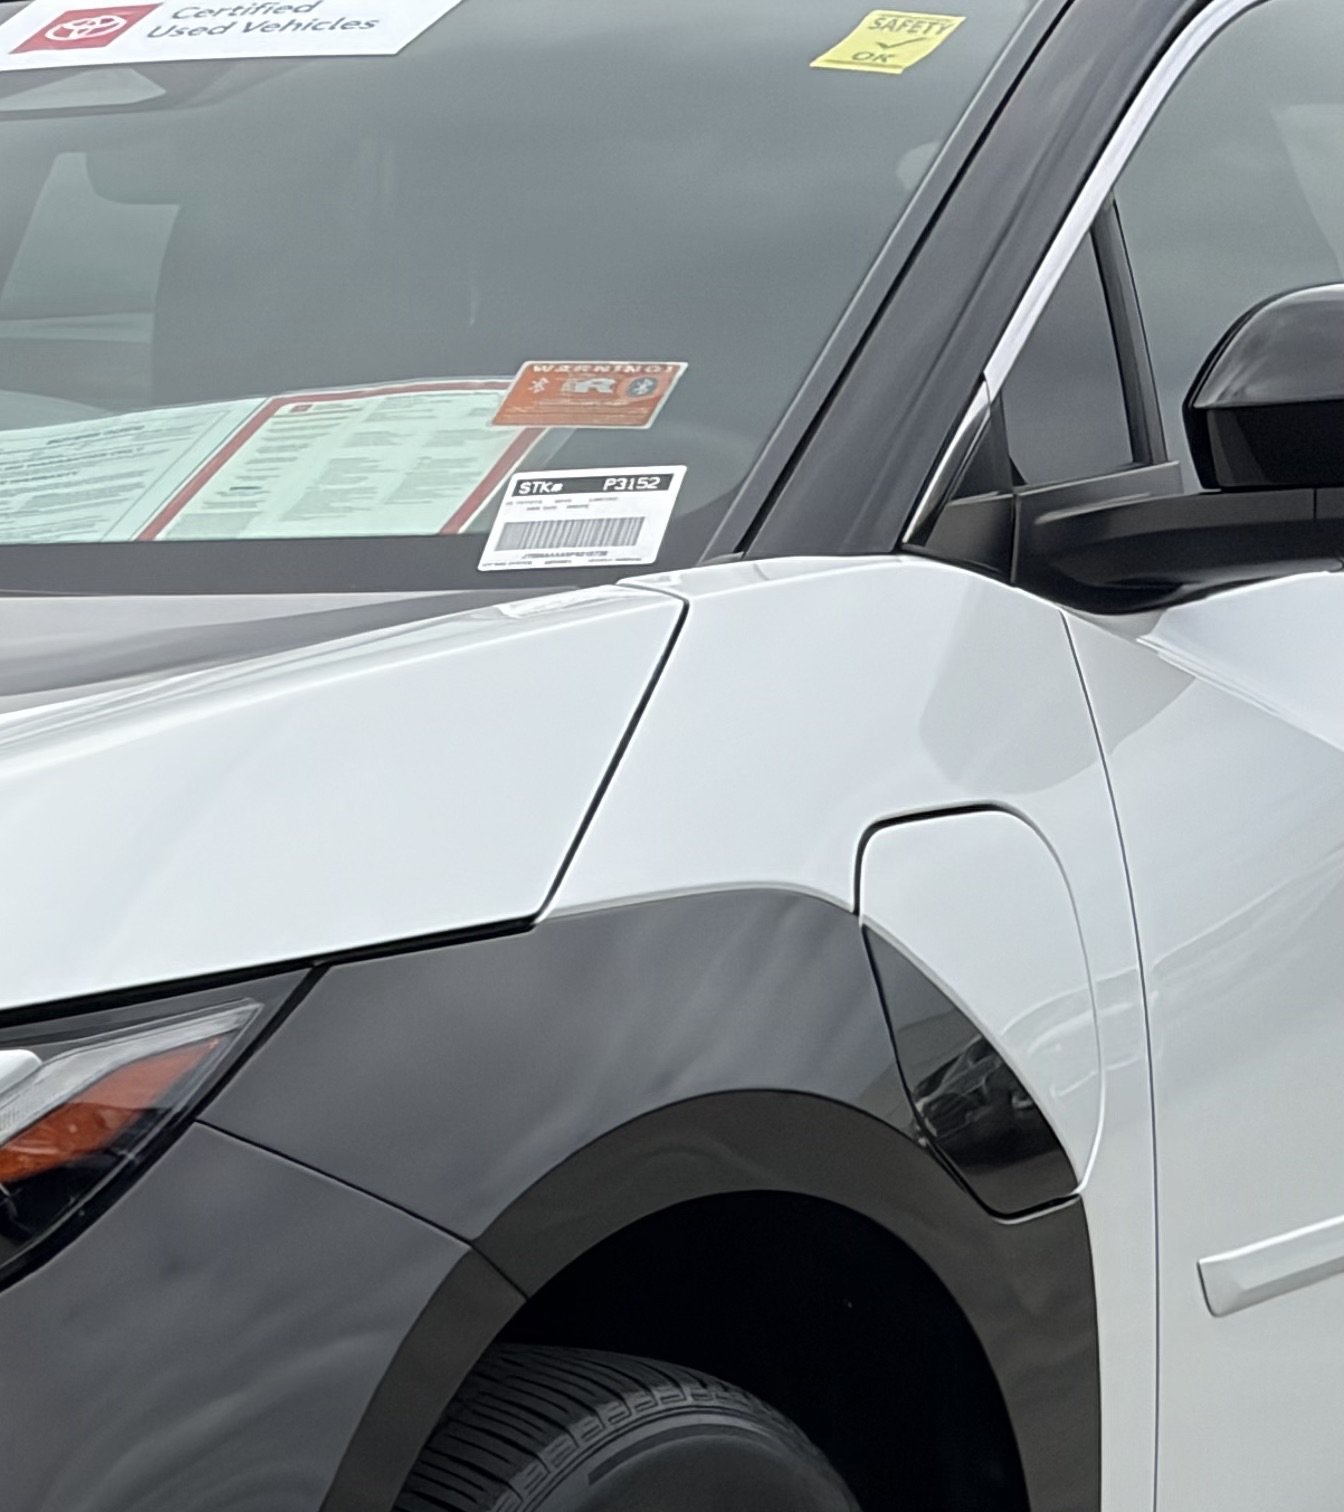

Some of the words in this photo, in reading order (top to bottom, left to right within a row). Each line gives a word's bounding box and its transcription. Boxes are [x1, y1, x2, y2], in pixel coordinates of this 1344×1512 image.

[170, 0, 321, 19] Certified
[147, 21, 234, 38] Used
[241, 17, 380, 34] Vehicles
[868, 18, 954, 35] SAFETY
[851, 51, 896, 63] OK
[518, 480, 564, 495] STK#
[603, 477, 661, 491] P3152
